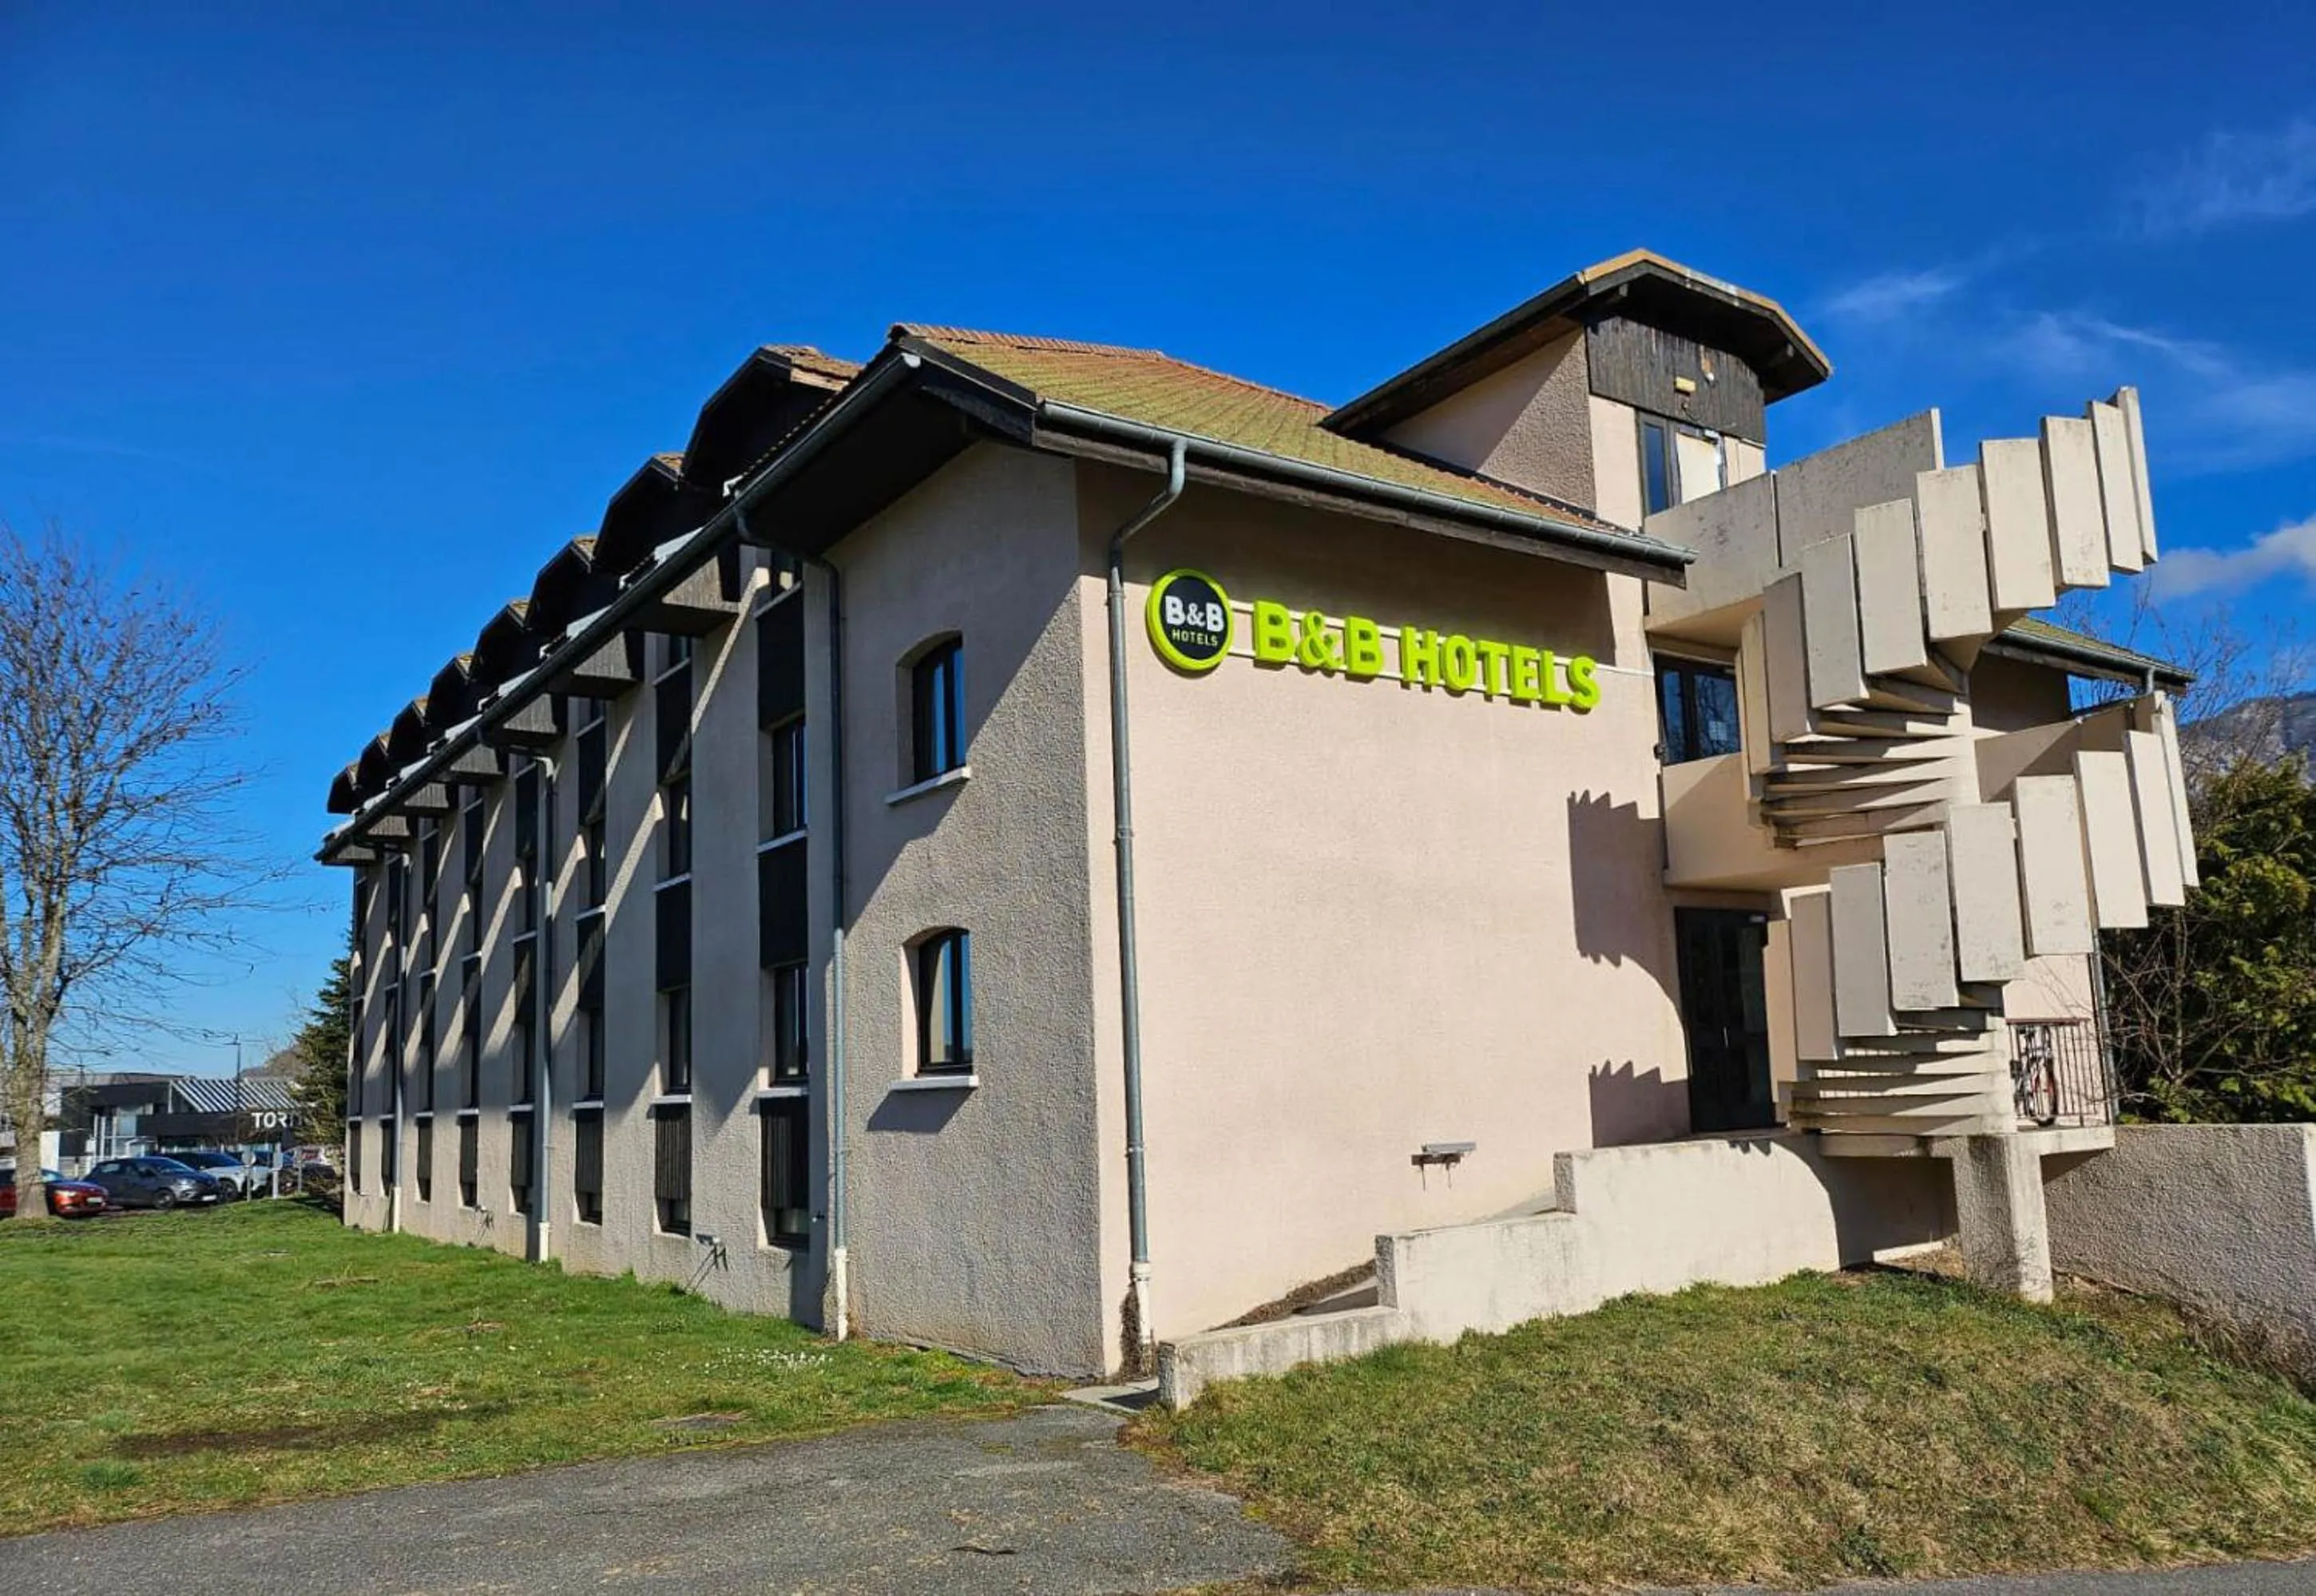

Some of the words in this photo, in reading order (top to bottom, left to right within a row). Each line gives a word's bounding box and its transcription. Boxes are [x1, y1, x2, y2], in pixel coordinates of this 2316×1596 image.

[1165, 595, 1224, 632] B&B
[1172, 628, 1218, 647] HOTELS
[1254, 600, 1383, 675] B&B
[1401, 626, 1600, 708] HOTELS
